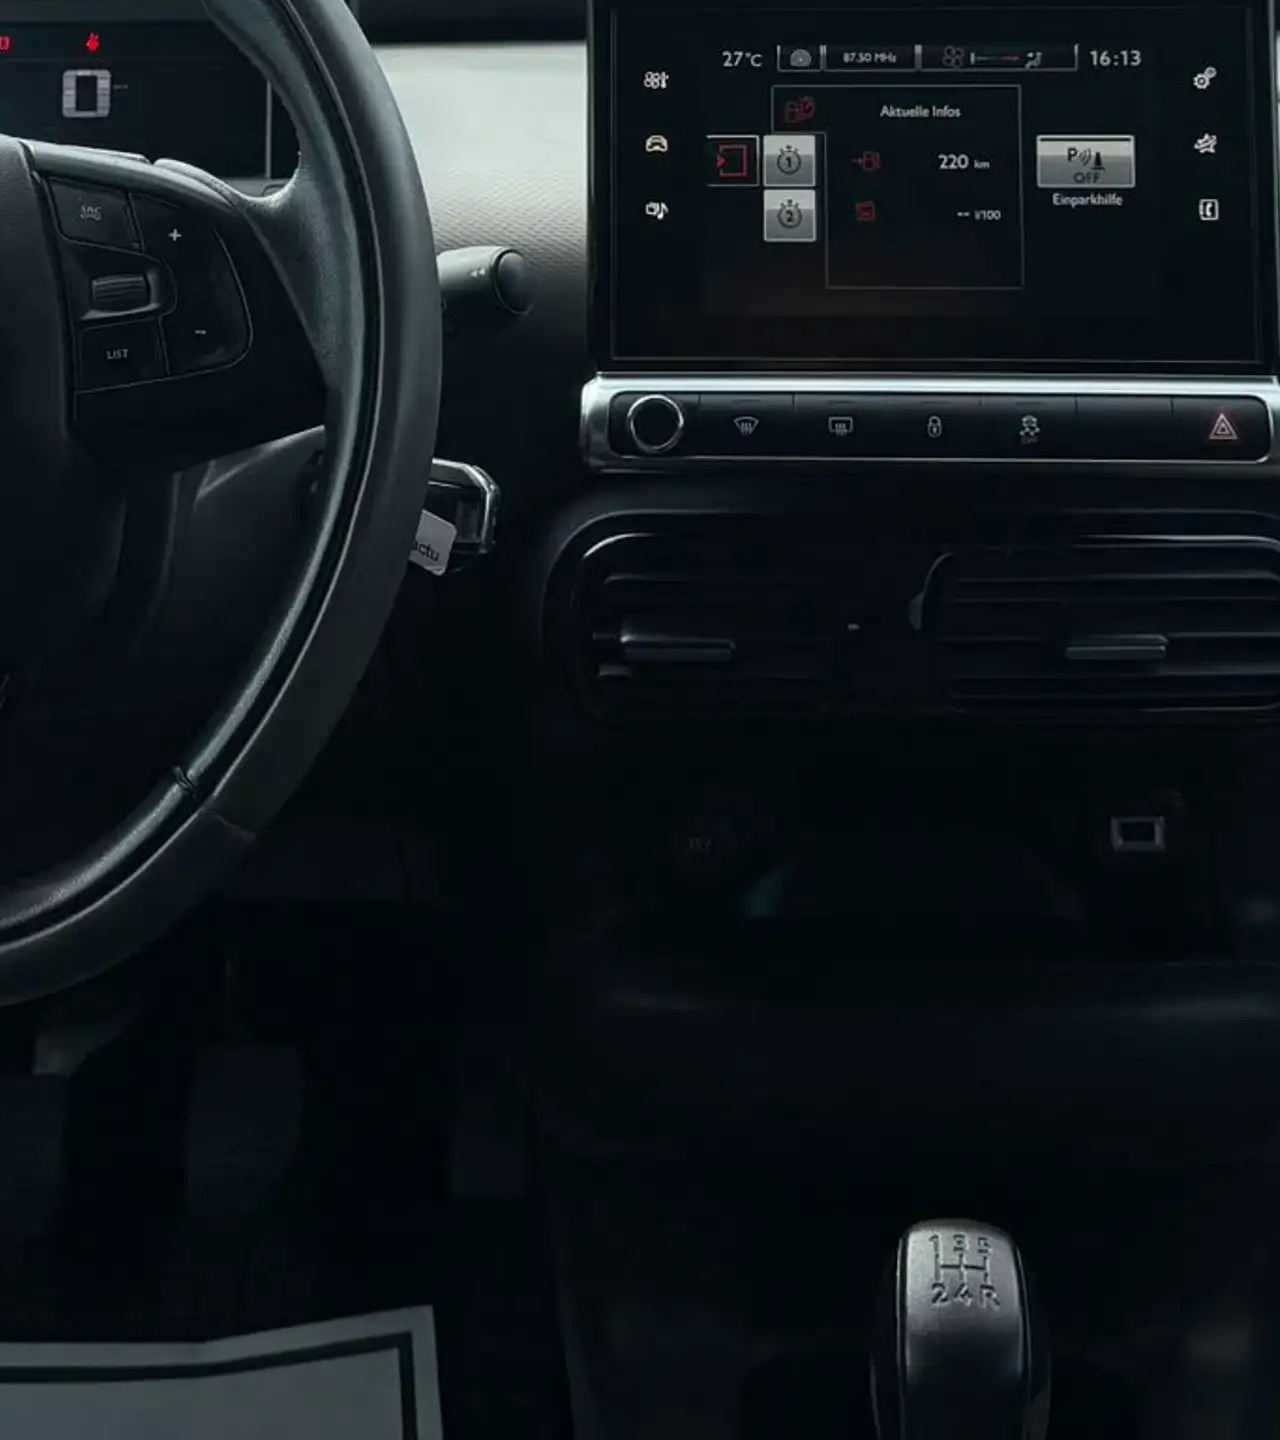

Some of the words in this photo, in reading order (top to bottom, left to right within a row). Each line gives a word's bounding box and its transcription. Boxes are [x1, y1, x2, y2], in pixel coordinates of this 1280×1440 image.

[722, 50, 763, 67] 27°C
[1090, 50, 1142, 68] 16:13
[62, 68, 112, 118] 0
[880, 105, 929, 118] Aktuelle
[932, 105, 961, 118] Infos
[938, 154, 969, 170] 220
[1073, 172, 1101, 185] OFF
[1052, 192, 1123, 208] Einparkhilfe
[931, 1281, 949, 1306] 2
[980, 1283, 1001, 1308] R
